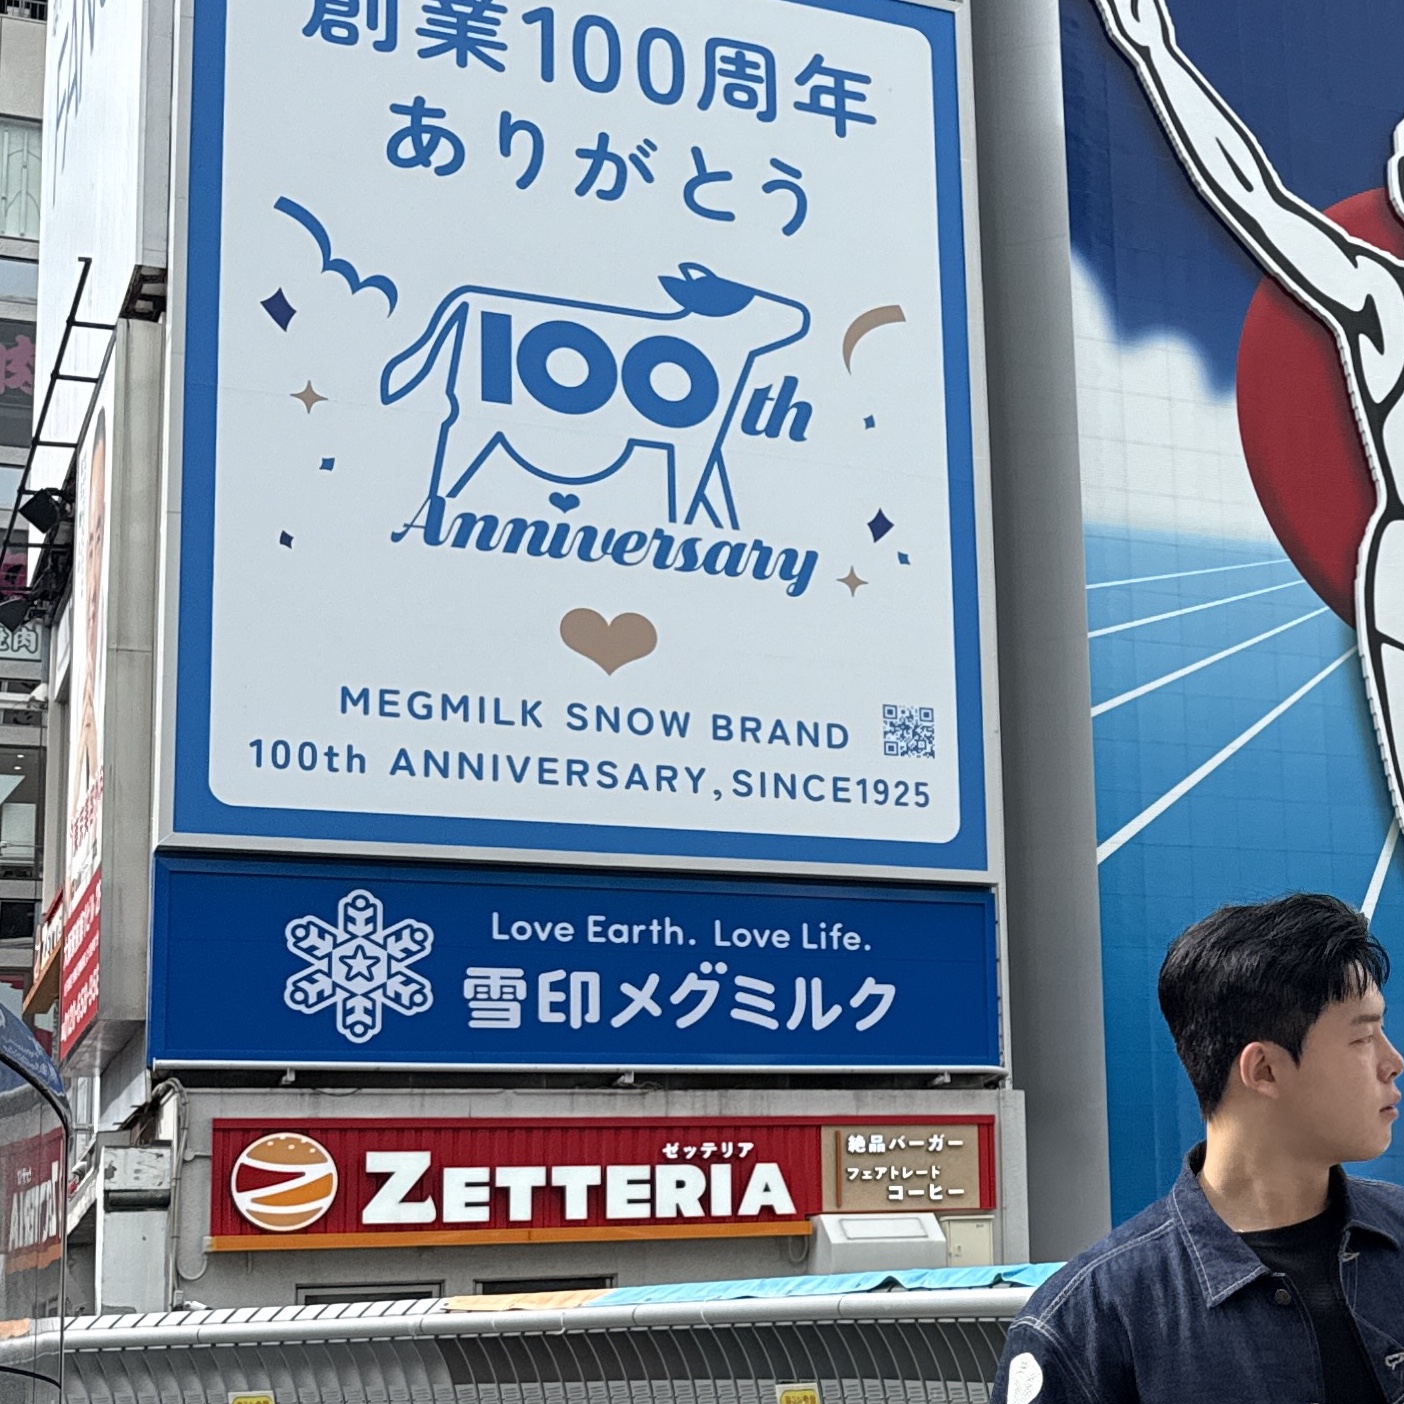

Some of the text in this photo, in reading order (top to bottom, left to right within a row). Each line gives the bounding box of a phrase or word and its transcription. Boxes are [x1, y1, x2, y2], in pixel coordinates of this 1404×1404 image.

[302, 0, 878, 139] 創業100周年
[386, 96, 809, 237] ありがとう
[391, 495, 819, 598] Anniversary
[340, 685, 850, 749] MEGMILK SNOW BRAND
[249, 738, 366, 775] 100th
[493, 912, 872, 951] Love Earth. Love Life.
[463, 960, 897, 1031] 雪印メグミルク
[662, 1141, 755, 1160] ゼッテリア
[847, 1133, 964, 1154] 絶品バーガー
[362, 1150, 797, 1224] ZETTERIA
[847, 1164, 942, 1181] フェアトレード
[888, 1183, 965, 1201] コーヒー
